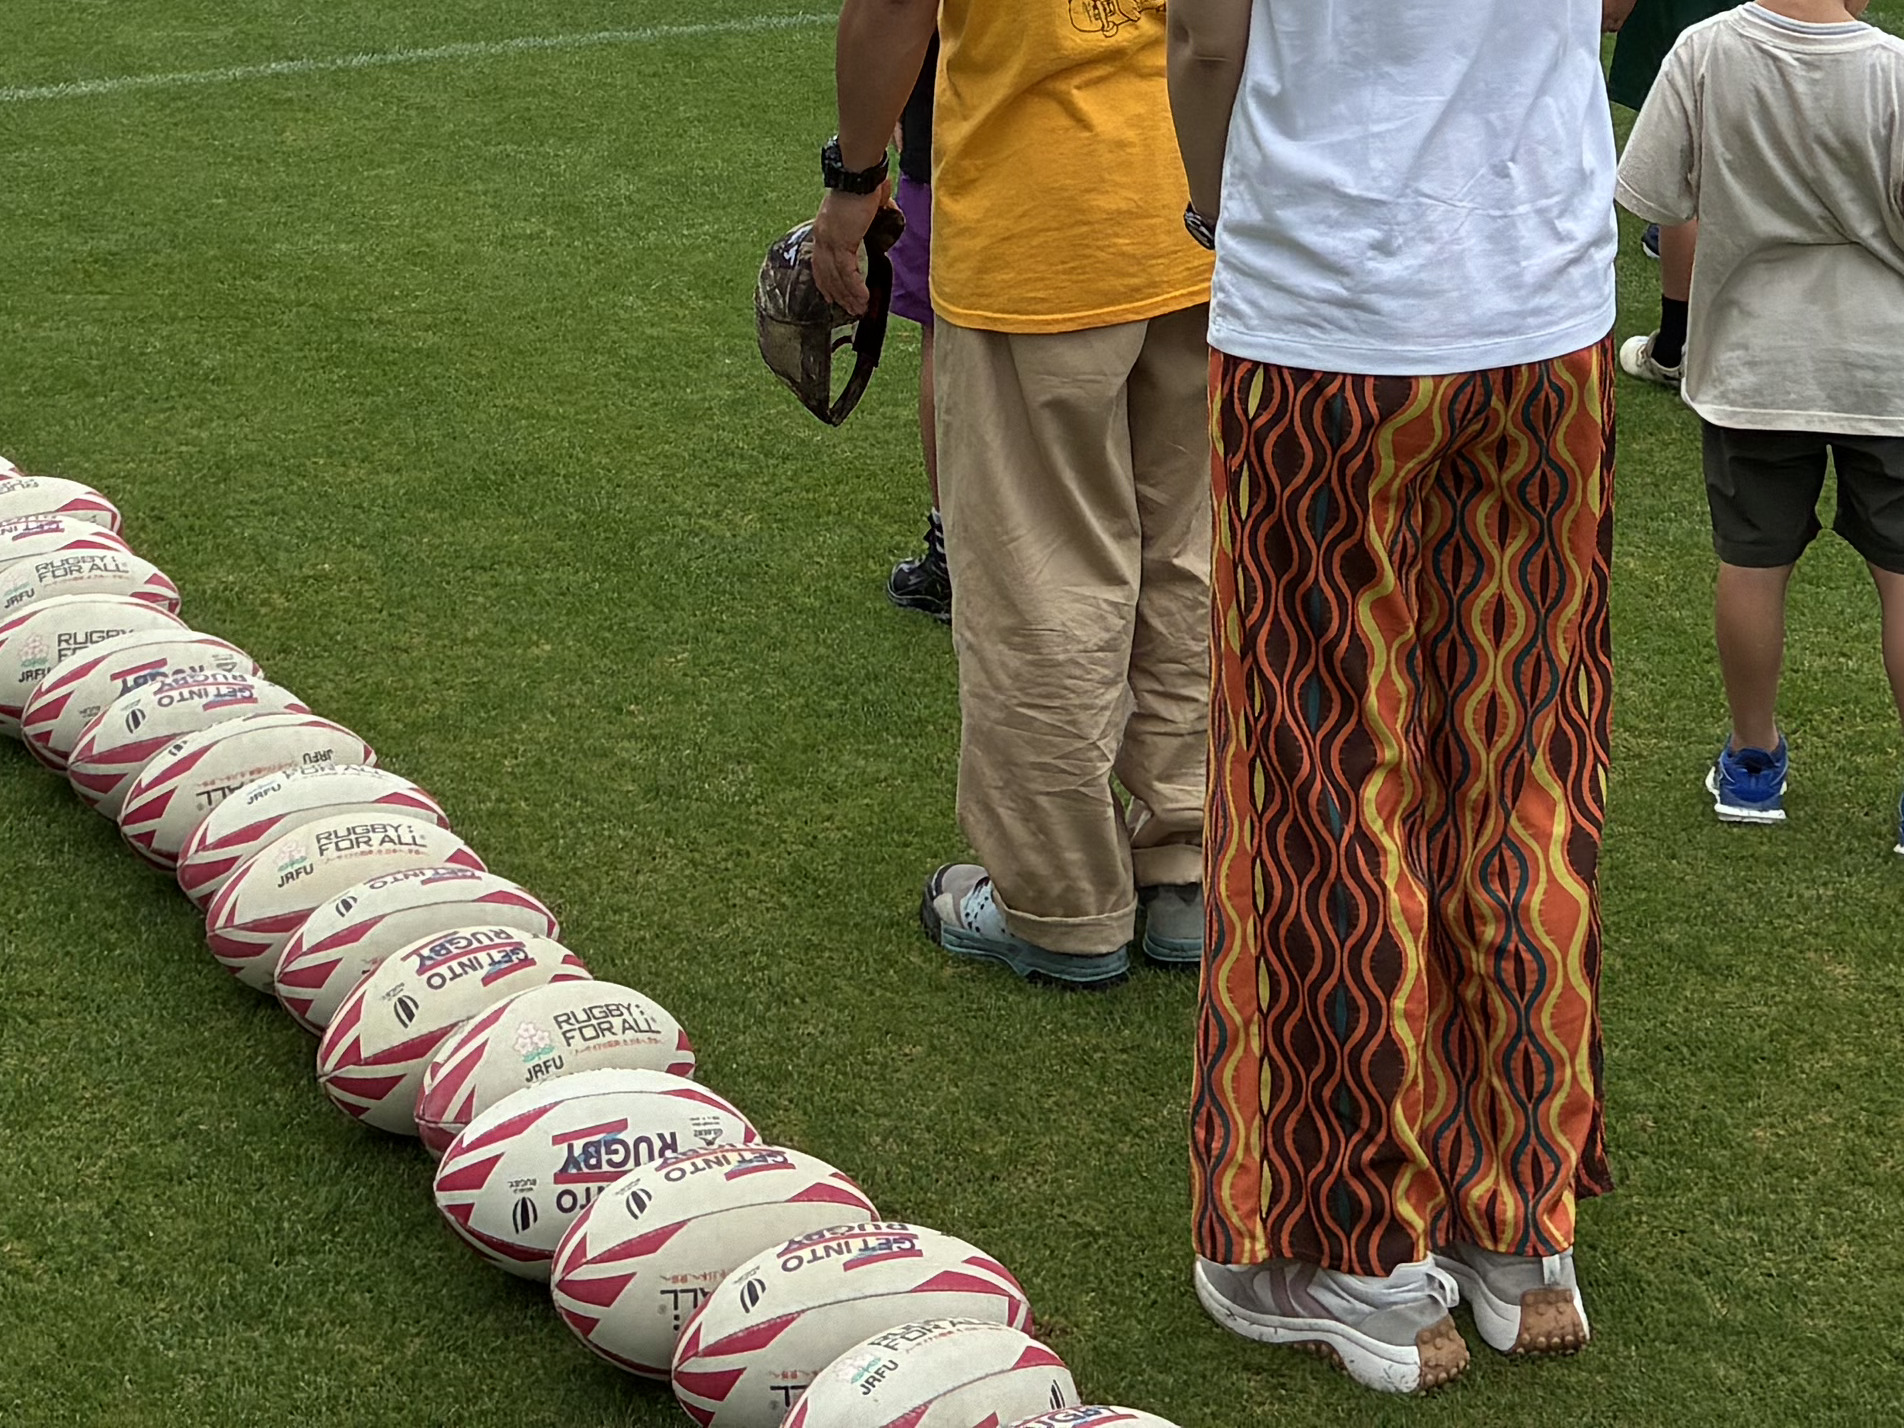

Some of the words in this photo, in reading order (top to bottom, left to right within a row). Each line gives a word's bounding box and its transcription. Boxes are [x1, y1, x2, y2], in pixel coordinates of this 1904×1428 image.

[37, 564, 86, 583] FOR
[88, 562, 130, 574] ALL
[157, 687, 209, 708] INTO
[213, 685, 254, 700] GET
[302, 748, 334, 765] JRFU
[318, 836, 373, 857] FOR
[379, 834, 428, 848] ALL
[277, 862, 314, 889] JRFU
[368, 870, 426, 890] INTO
[415, 928, 514, 971] RUGBY
[485, 947, 530, 971] GET
[426, 957, 482, 990] INTO
[561, 1020, 618, 1047] FOR
[622, 1018, 662, 1035] ALL
[525, 1055, 564, 1083] JRFU
[559, 1131, 679, 1175] RUGBY
[737, 1150, 789, 1166] GET
[664, 1153, 731, 1183] INTO
[781, 1241, 853, 1273] INTO
[858, 1237, 916, 1253] GET
[859, 1359, 899, 1396] JRFU
